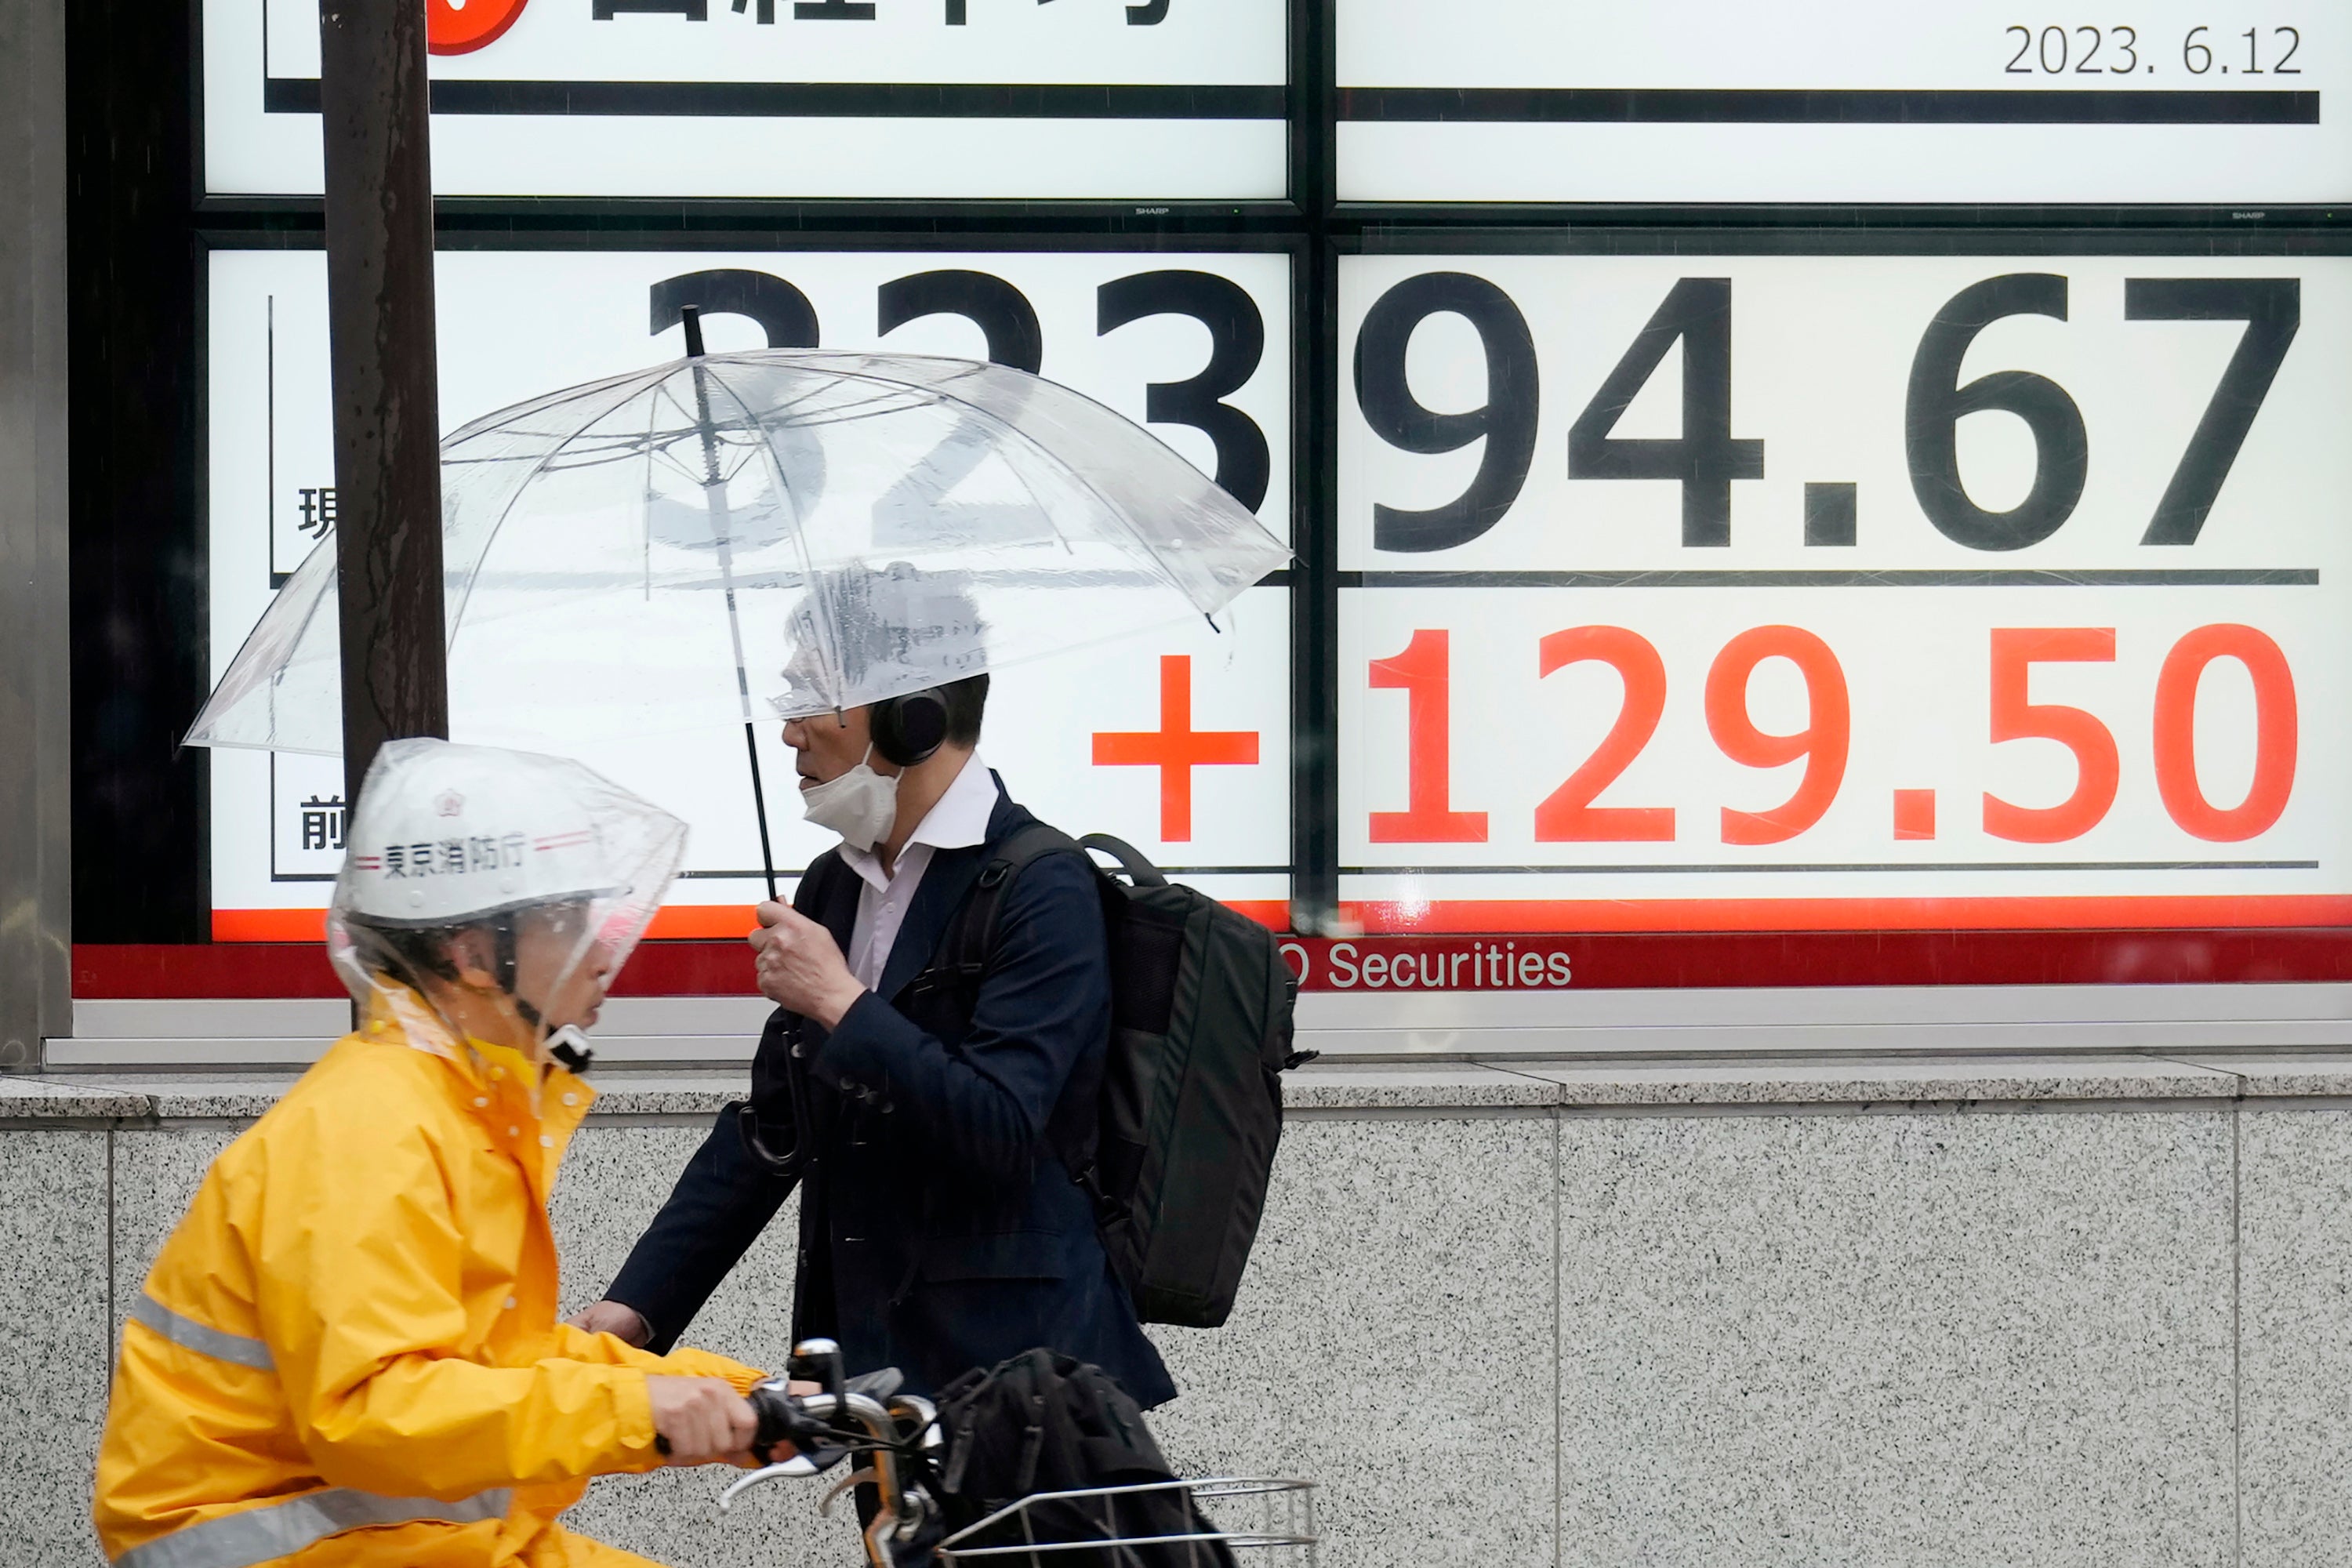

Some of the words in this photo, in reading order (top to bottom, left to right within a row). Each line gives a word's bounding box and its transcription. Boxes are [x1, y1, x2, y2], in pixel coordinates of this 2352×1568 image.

[2005, 25, 2154, 74] 2023.
[2183, 25, 2302, 74] 6.12
[1134, 207, 1170, 216] SHARP
[384, 831, 526, 880] 東京消防庁
[1328, 942, 1572, 989] Securities
